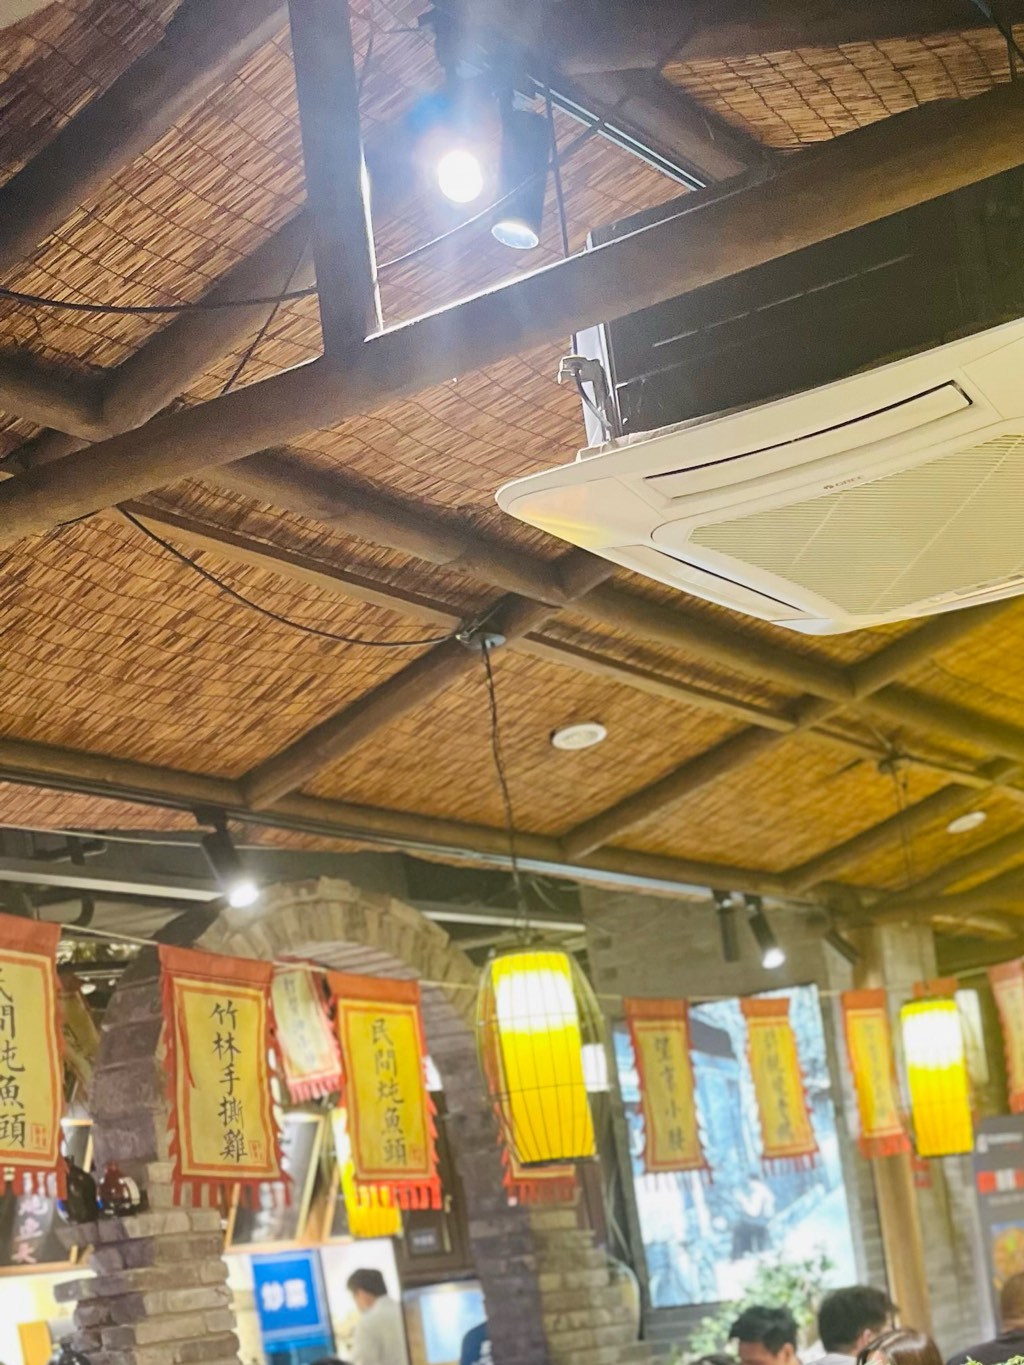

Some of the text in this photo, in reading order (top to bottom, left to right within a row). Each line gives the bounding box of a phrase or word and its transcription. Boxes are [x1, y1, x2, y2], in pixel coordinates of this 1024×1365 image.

[209, 999, 248, 1163] 竹林手撕雞
